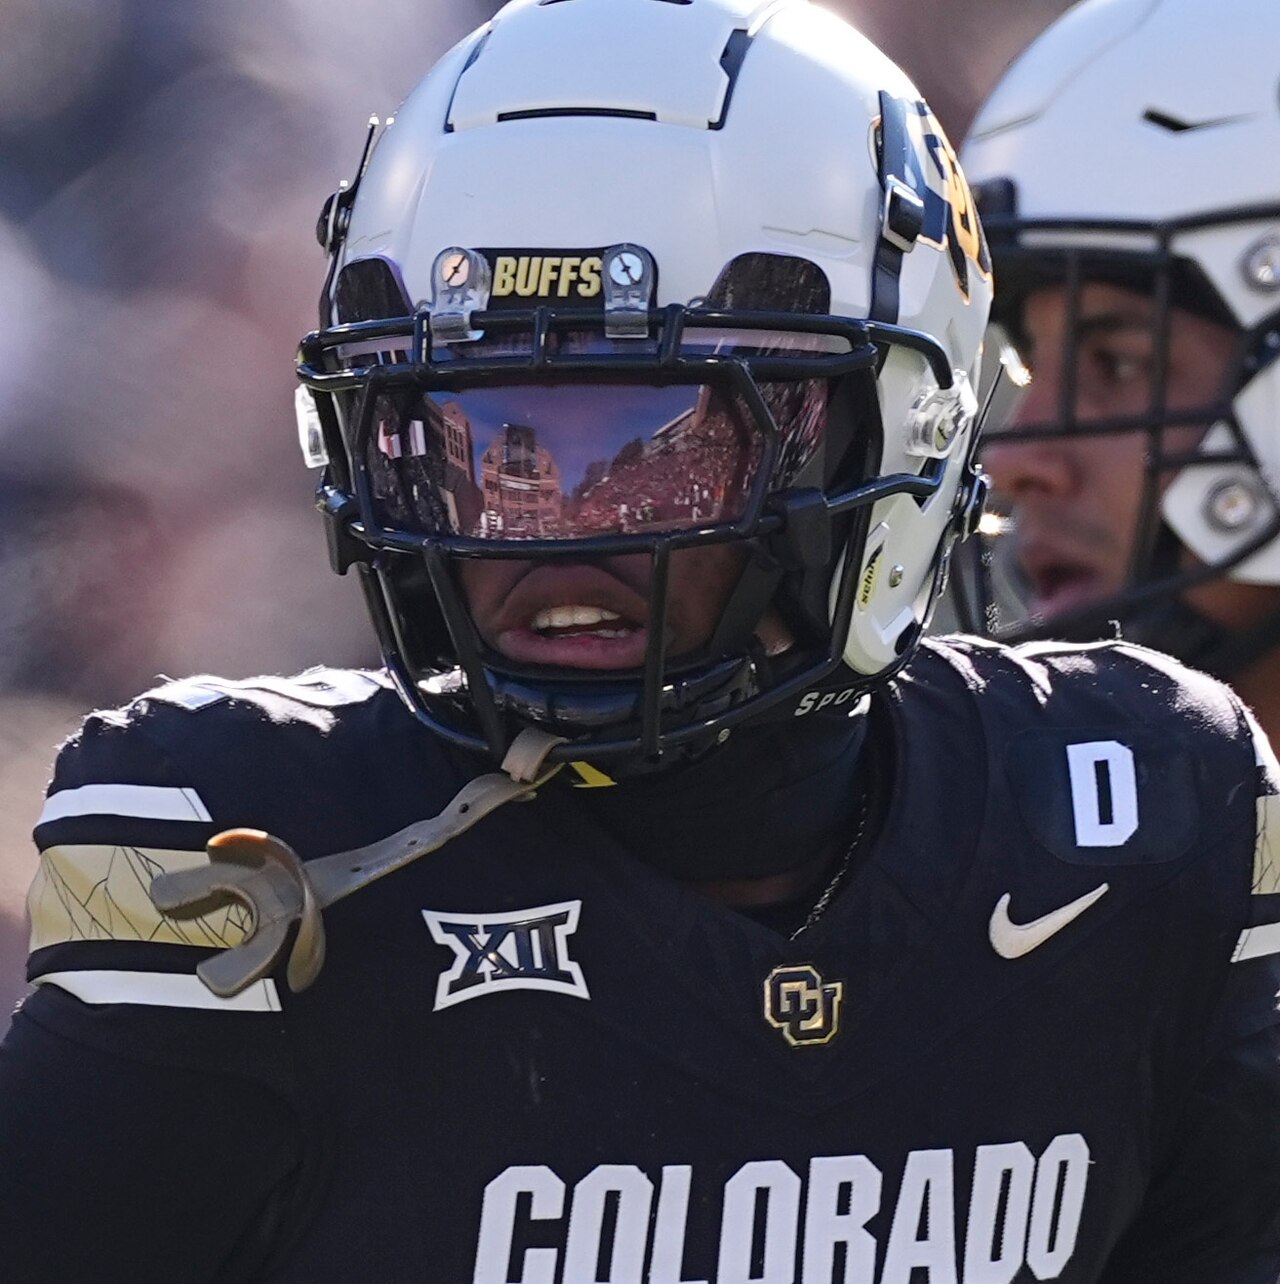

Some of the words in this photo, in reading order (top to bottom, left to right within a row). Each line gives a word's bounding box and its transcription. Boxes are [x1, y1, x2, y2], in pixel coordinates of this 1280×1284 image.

[491, 256, 603, 297] BUFFS
[1066, 740, 1139, 847] D
[438, 910, 577, 996] XII
[764, 965, 842, 1047] CU
